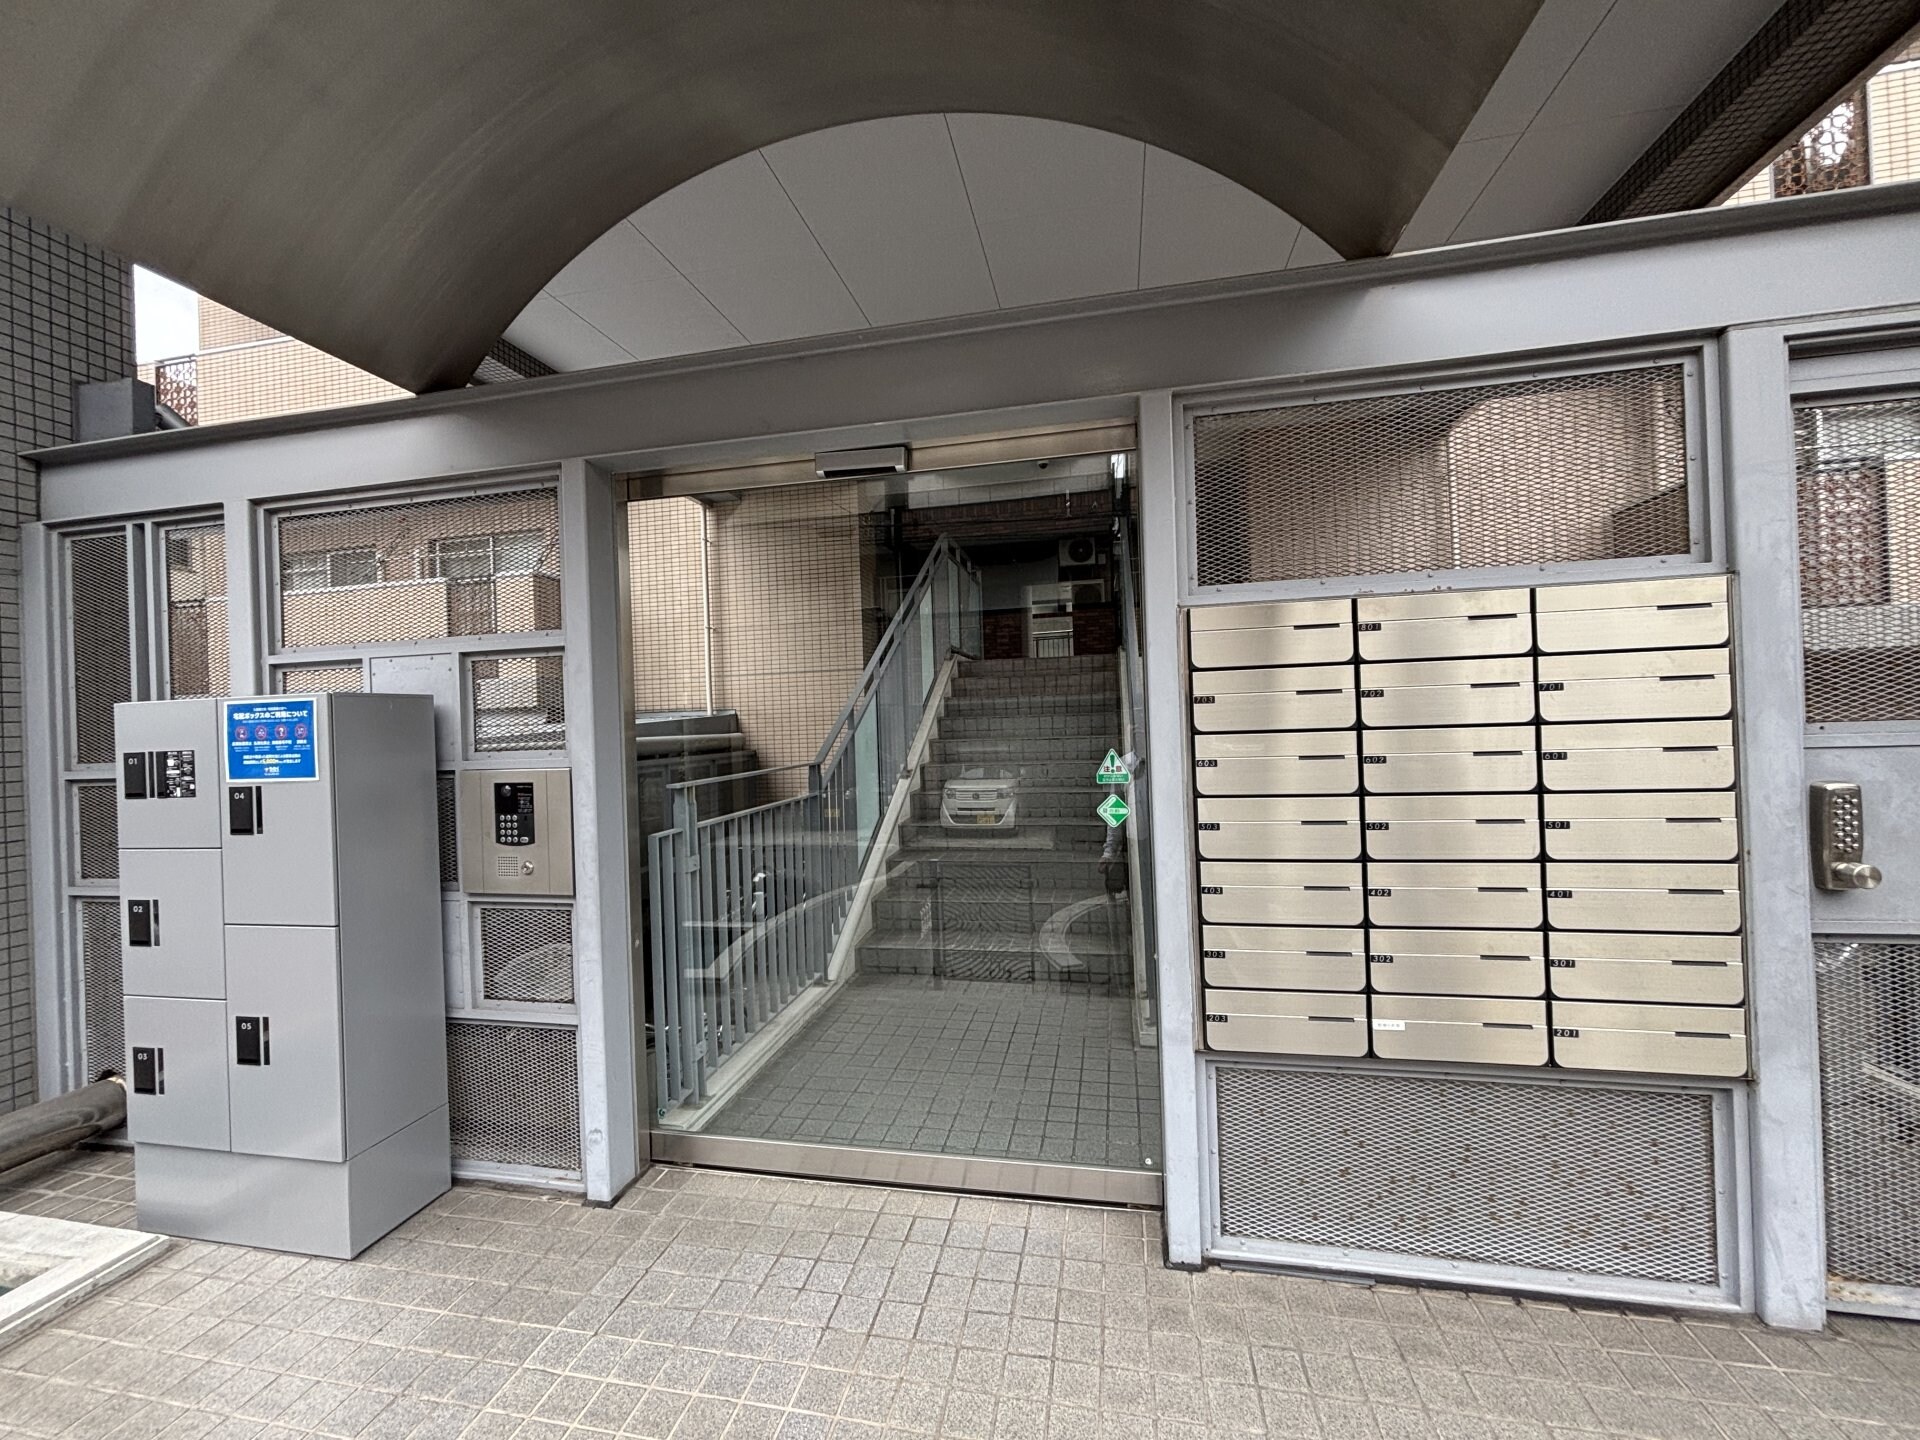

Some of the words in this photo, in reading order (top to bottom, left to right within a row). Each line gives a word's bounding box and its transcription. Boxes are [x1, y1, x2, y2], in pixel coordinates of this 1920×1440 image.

[1361, 623, 1379, 631] 801
[1545, 752, 1565, 760] 601
[234, 792, 245, 800] 04
[1368, 822, 1386, 830] 502
[1549, 821, 1567, 829] 501
[1550, 890, 1570, 898] 401
[1206, 950, 1223, 958] 303
[1373, 955, 1391, 963] 302
[1553, 959, 1573, 967] 301
[1209, 1014, 1226, 1022] 203
[241, 1022, 252, 1030] 05
[1557, 1029, 1577, 1037] 201
[137, 1053, 148, 1061] 03
